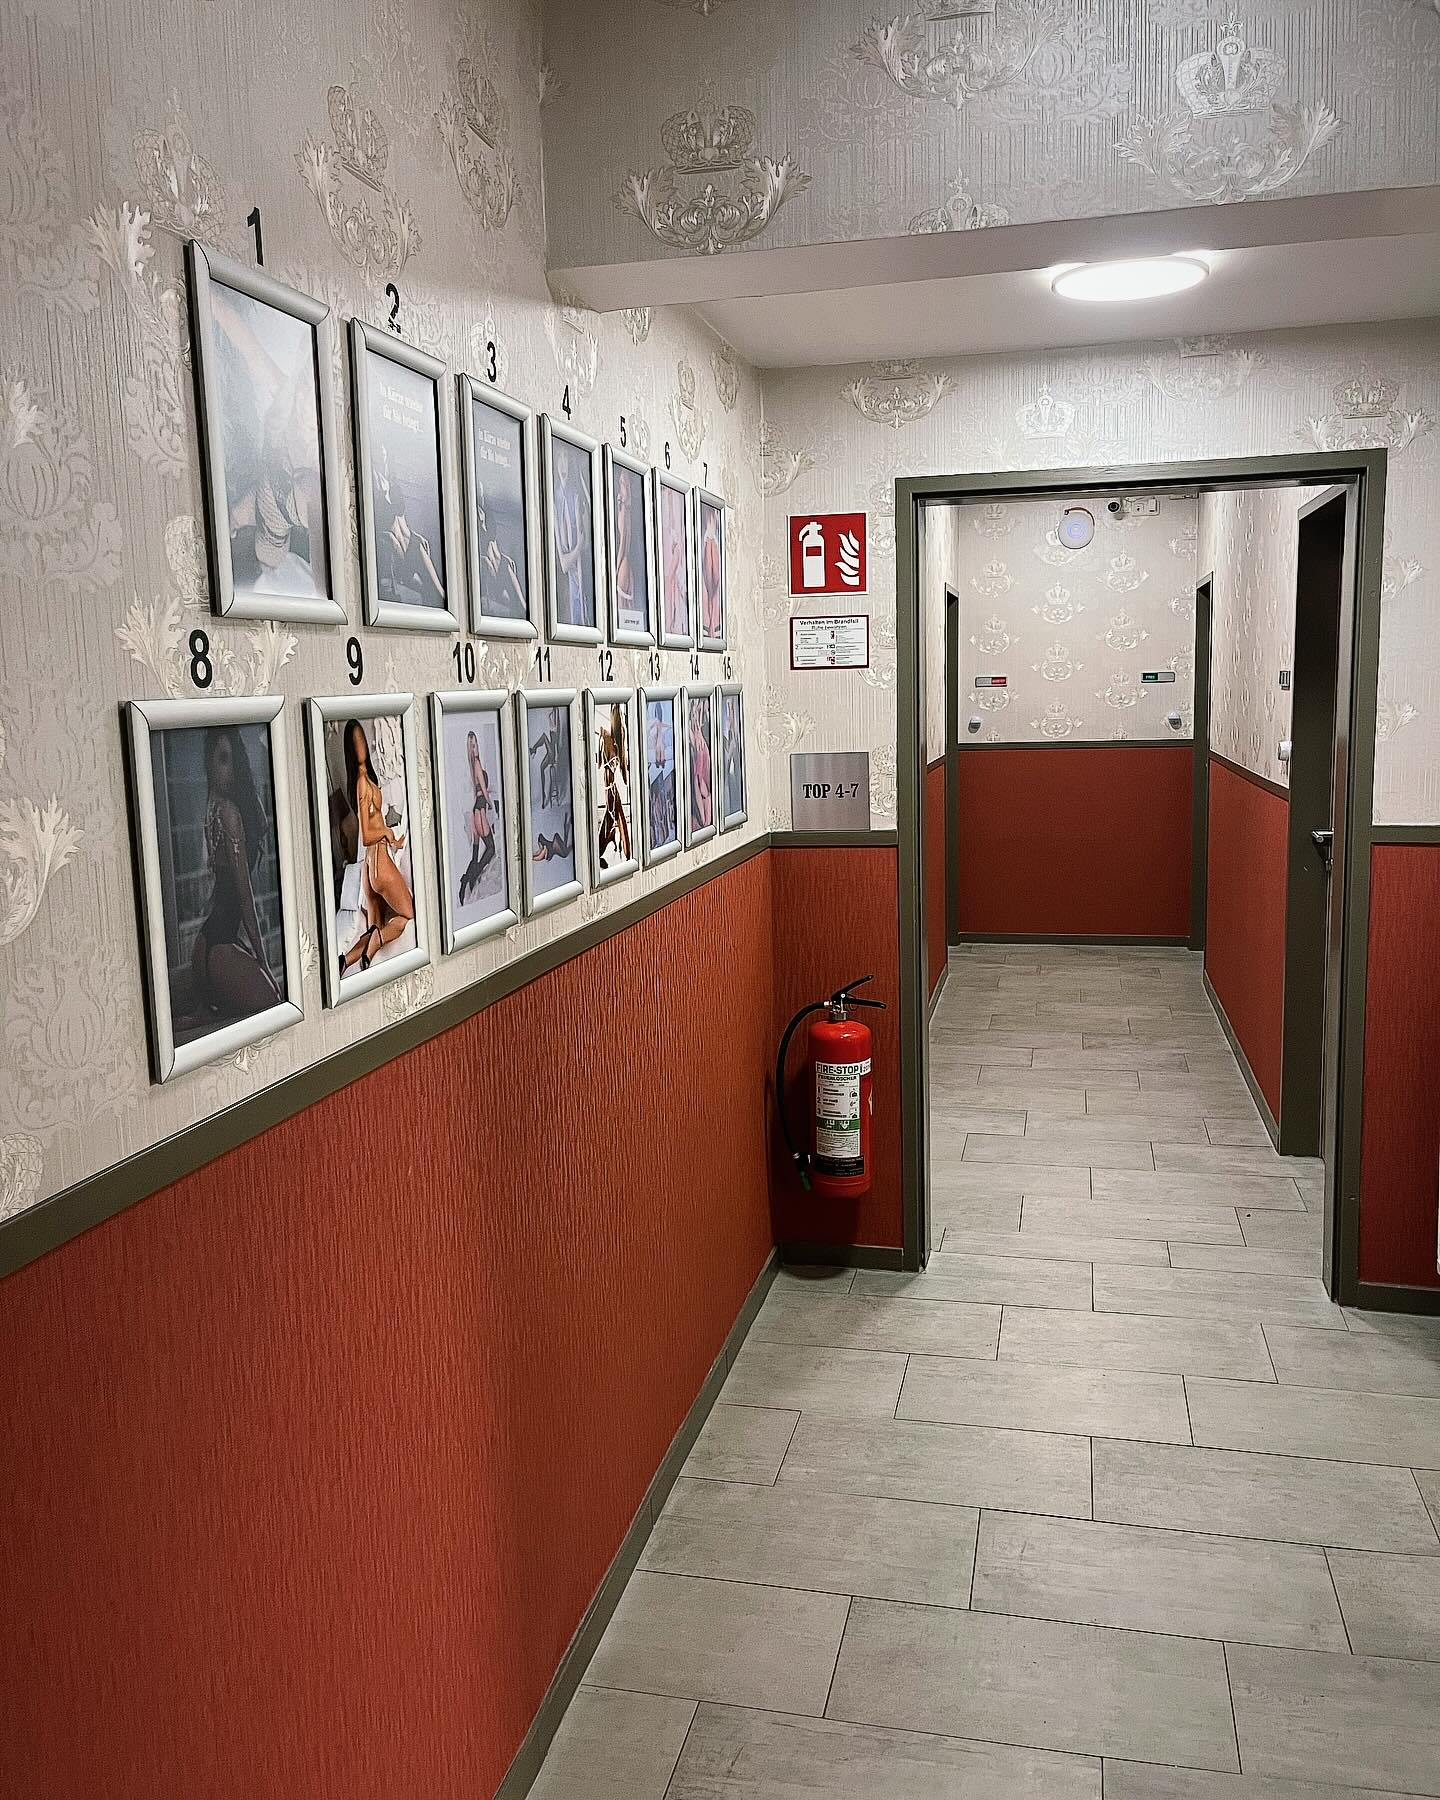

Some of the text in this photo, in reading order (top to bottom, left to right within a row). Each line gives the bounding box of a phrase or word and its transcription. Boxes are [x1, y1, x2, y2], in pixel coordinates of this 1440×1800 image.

[247, 206, 264, 266] 1
[386, 282, 402, 334] 2
[486, 341, 497, 383] 3
[562, 384, 572, 420] 4
[619, 415, 628, 449] 5
[664, 441, 672, 471] 6
[703, 462, 709, 488] 7
[189, 630, 213, 689] 8
[346, 637, 364, 686] 9
[452, 641, 476, 684] 10
[535, 646, 552, 683] 11
[598, 649, 614, 682] 12
[649, 652, 661, 681] 13
[689, 654, 700, 680] 14
[723, 656, 732, 680] 15
[802, 783, 860, 799] TOP 4-7
[816, 1063, 859, 1075] FIRE-STOP
